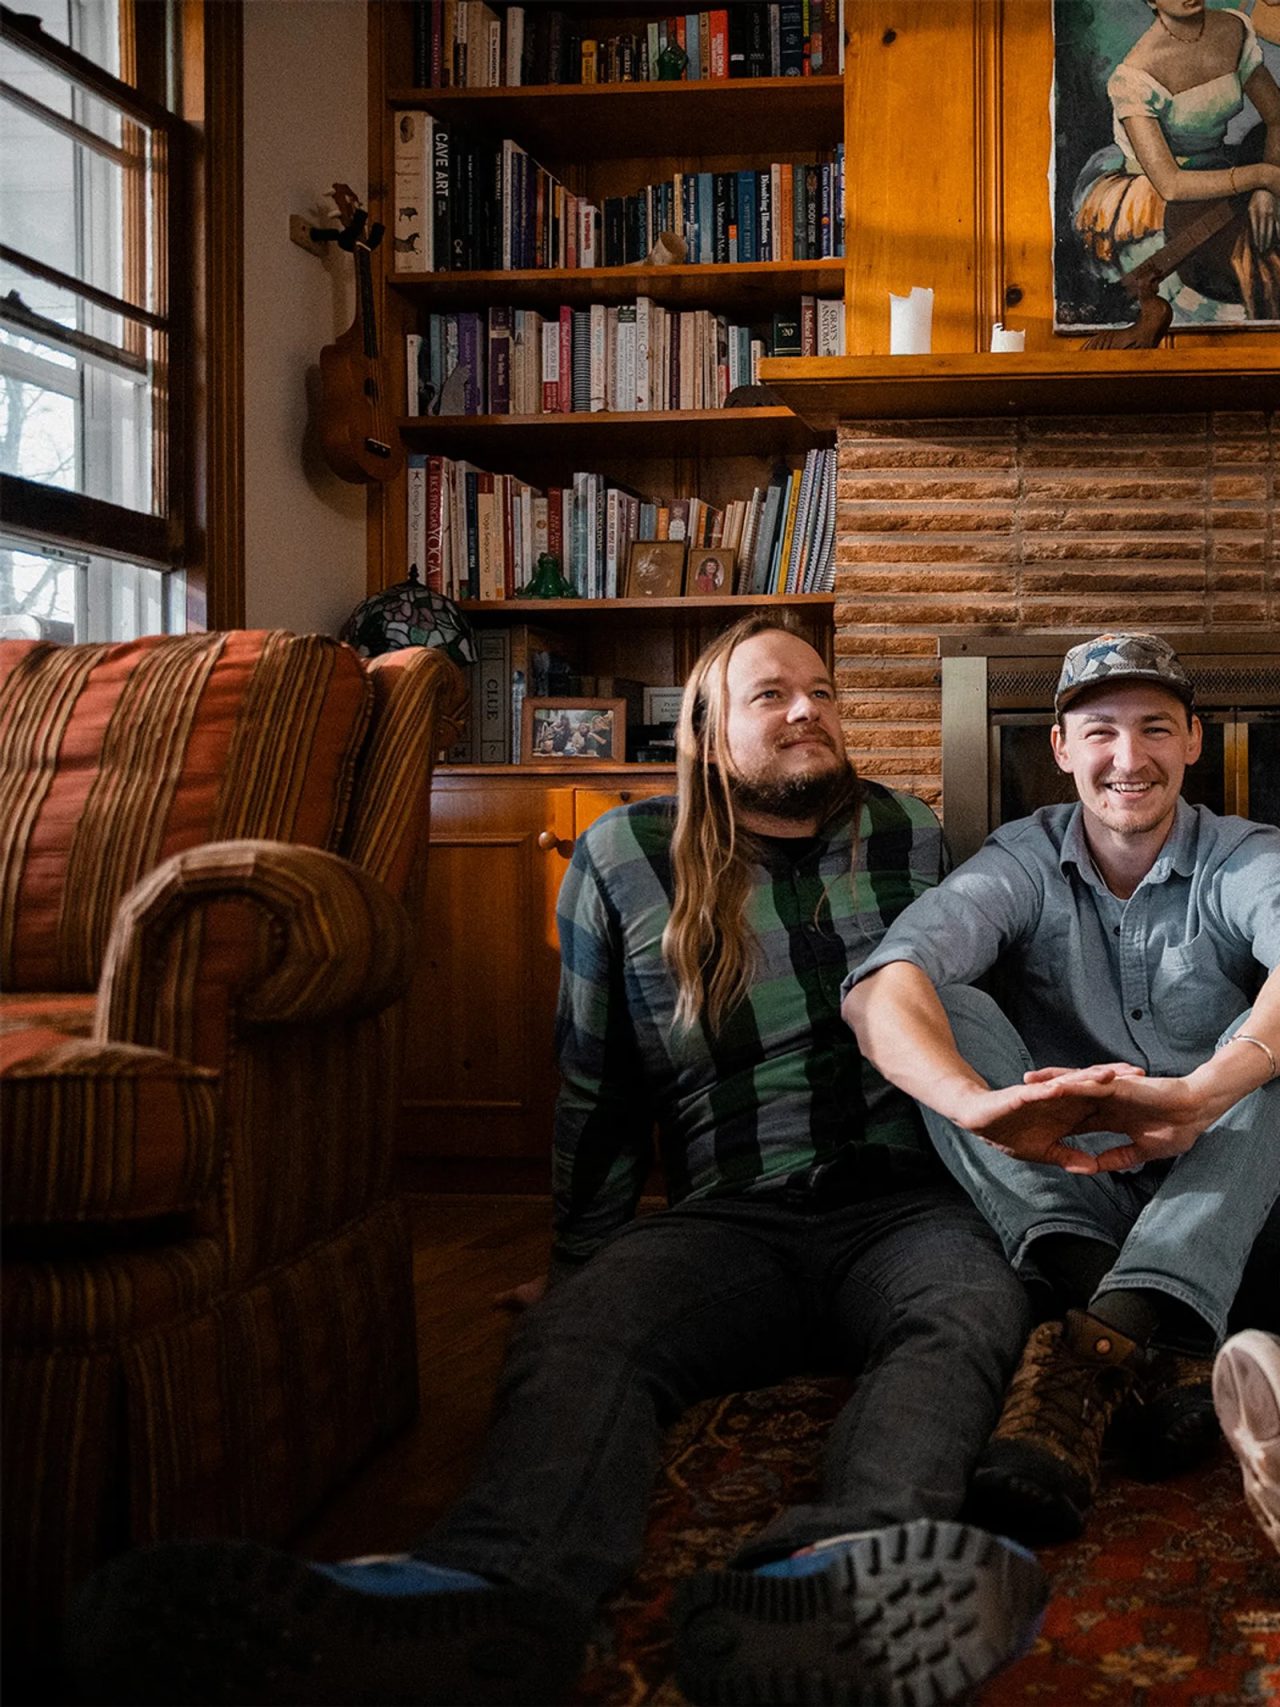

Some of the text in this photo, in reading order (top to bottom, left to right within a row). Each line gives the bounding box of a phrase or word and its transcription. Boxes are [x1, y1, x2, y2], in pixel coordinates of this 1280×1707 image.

[435, 133, 449, 197] CAVE ART
[760, 174, 770, 212] Dissolving
[822, 304, 830, 346] ANATOMY
[411, 513, 421, 531] Yoga
[483, 512, 491, 573] Yoga Sequencing
[428, 527, 441, 574] YOGA
[487, 679, 498, 720] CLUE
